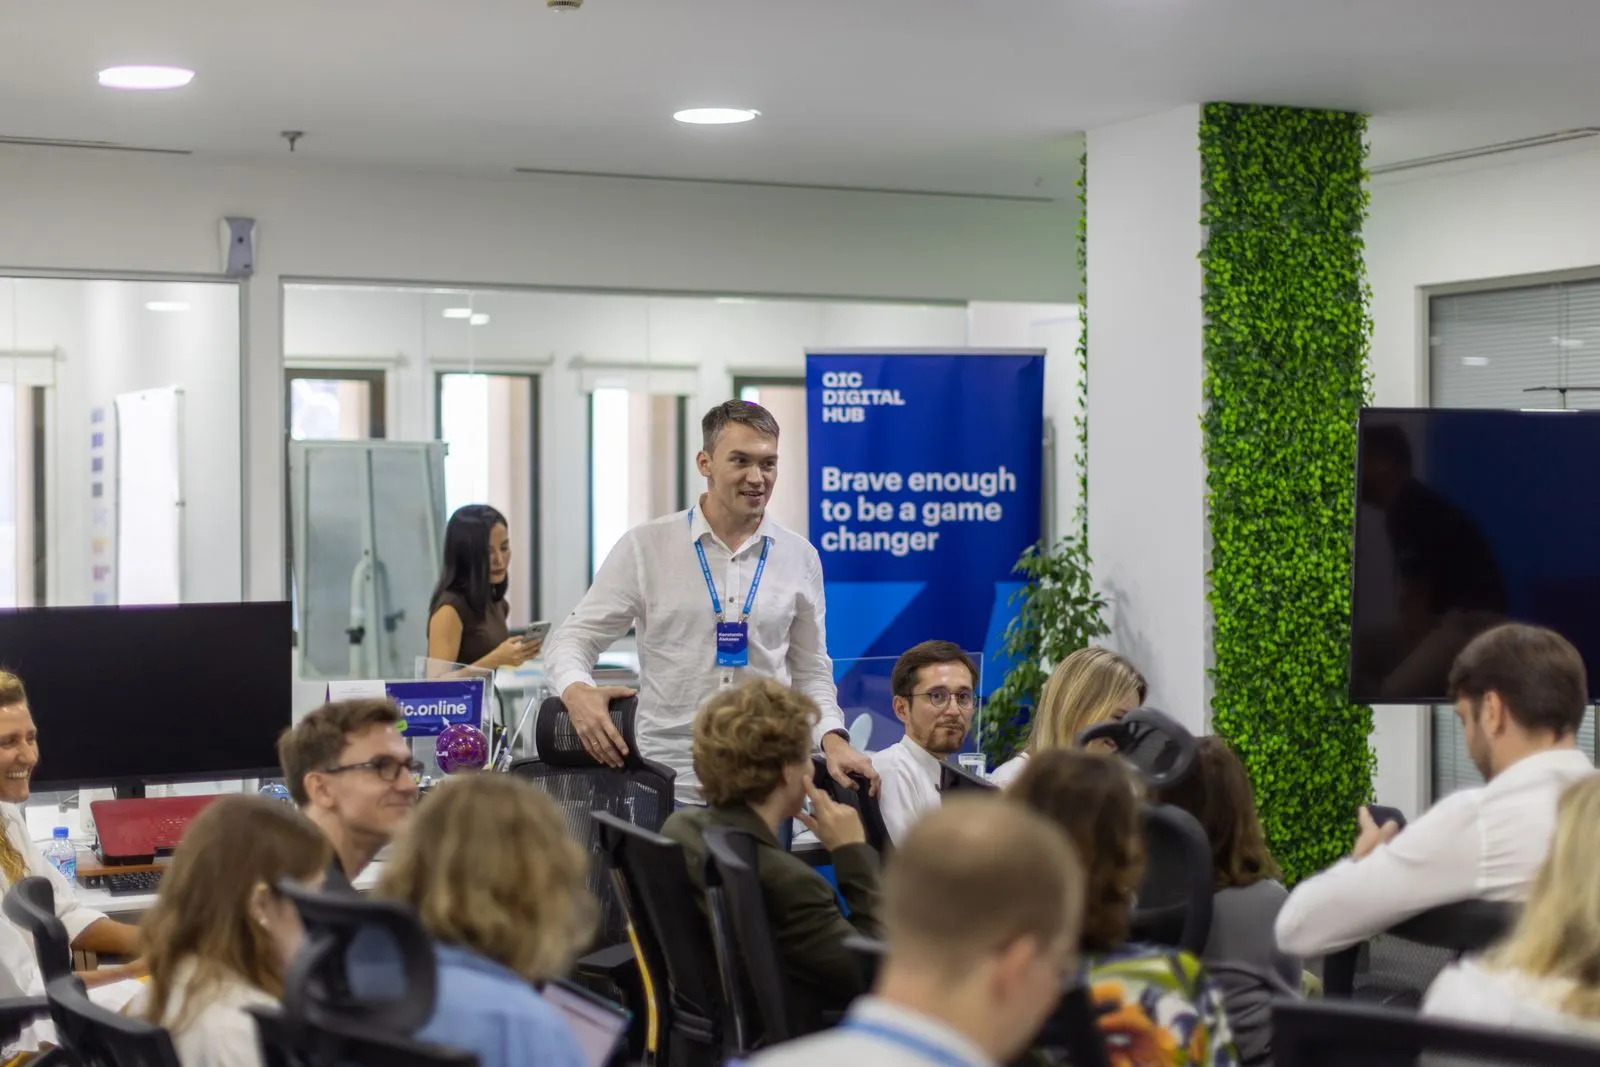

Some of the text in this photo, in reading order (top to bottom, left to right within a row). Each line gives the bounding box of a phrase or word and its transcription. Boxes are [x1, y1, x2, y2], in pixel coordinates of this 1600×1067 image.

[822, 372, 863, 388] QIC
[822, 389, 906, 406] DIGITAL
[822, 407, 866, 423] HUB
[821, 465, 1017, 497] Brave enough
[820, 495, 1003, 527] to be a game
[820, 525, 940, 557] changer
[400, 699, 467, 717] ic.online
